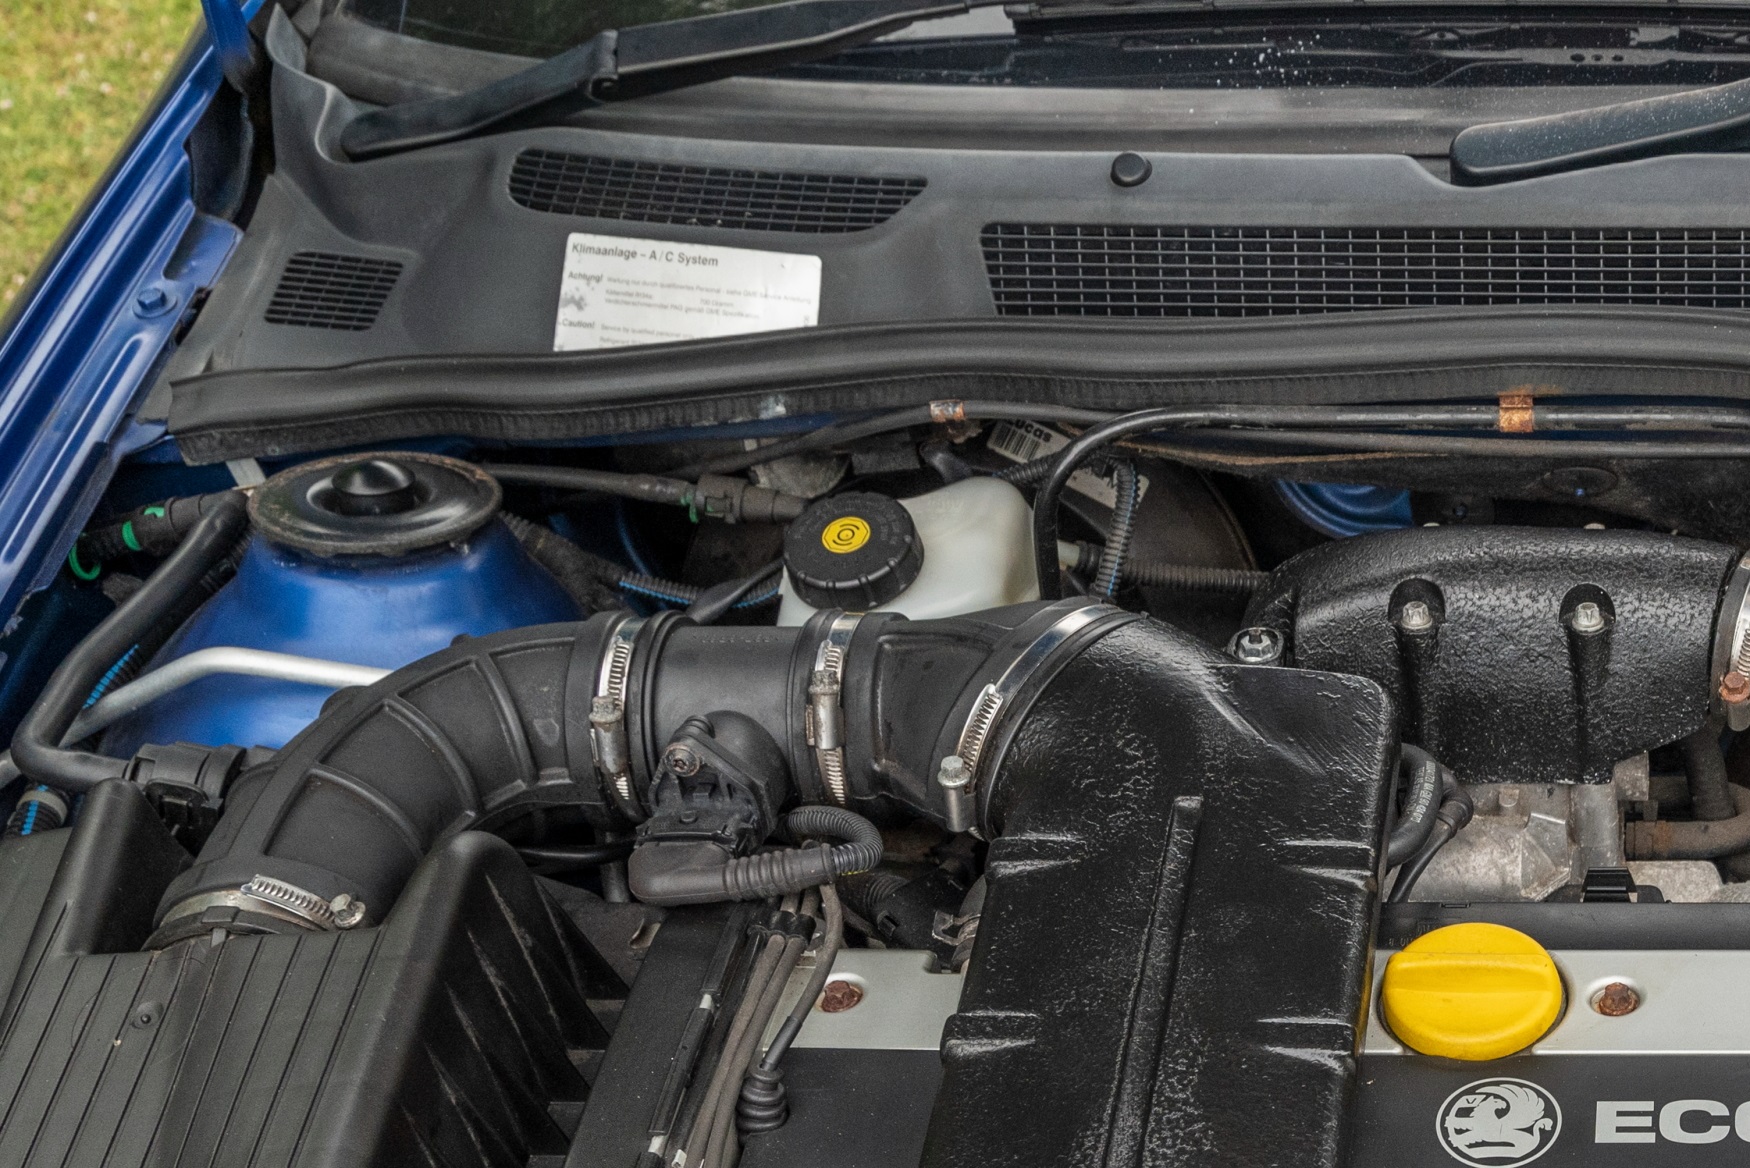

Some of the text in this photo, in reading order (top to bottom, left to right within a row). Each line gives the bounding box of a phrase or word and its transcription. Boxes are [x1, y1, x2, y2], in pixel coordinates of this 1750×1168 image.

[571, 242, 638, 260] Klimaanlage
[677, 252, 719, 266] System
[568, 270, 603, 282] Achtung!
[562, 318, 595, 329] Caution!
